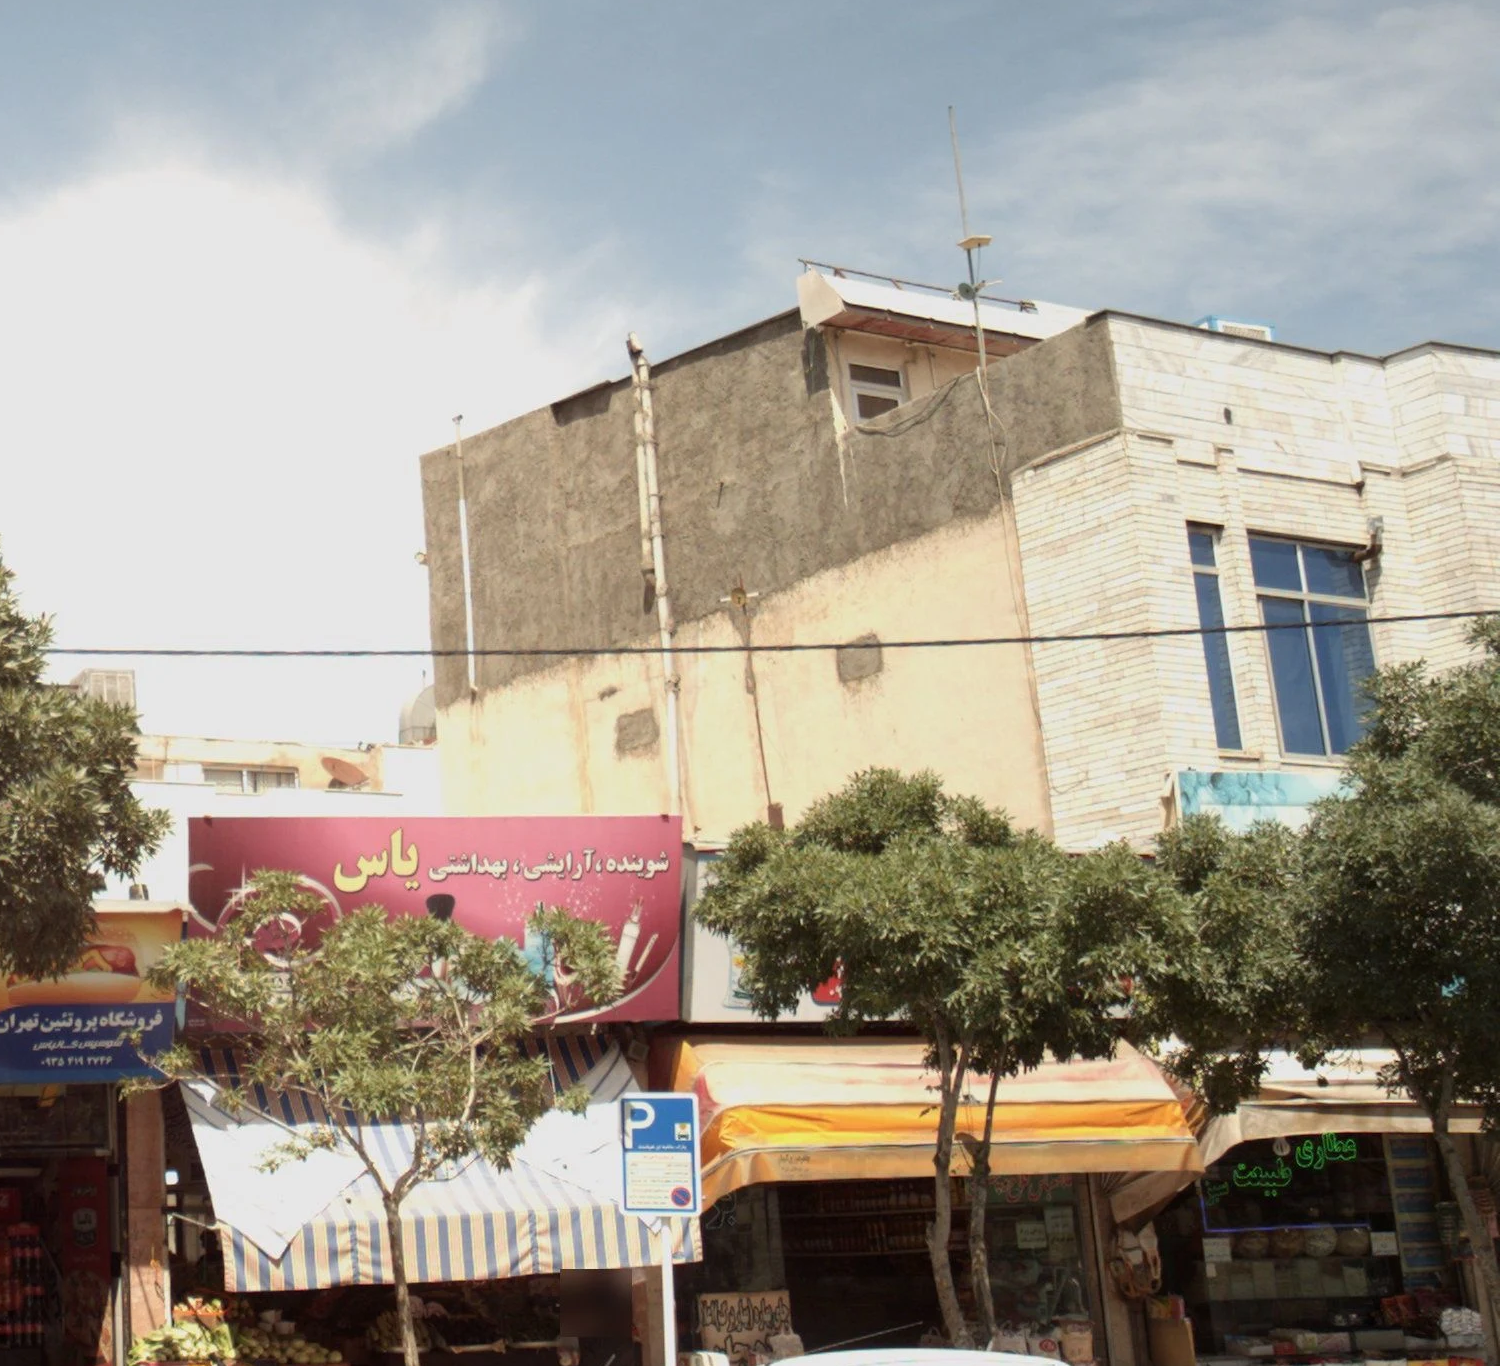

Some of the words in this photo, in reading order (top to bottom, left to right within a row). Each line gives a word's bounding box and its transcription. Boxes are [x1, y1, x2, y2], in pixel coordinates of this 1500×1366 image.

[333, 828, 420, 893] یاس
[428, 851, 509, 881] بهداشتی
[41, 1011, 98, 1034] پروتئین
[99, 1009, 163, 1032] فروشگاه
[624, 1101, 656, 1149] P
[1295, 1132, 1357, 1170] عطاری
